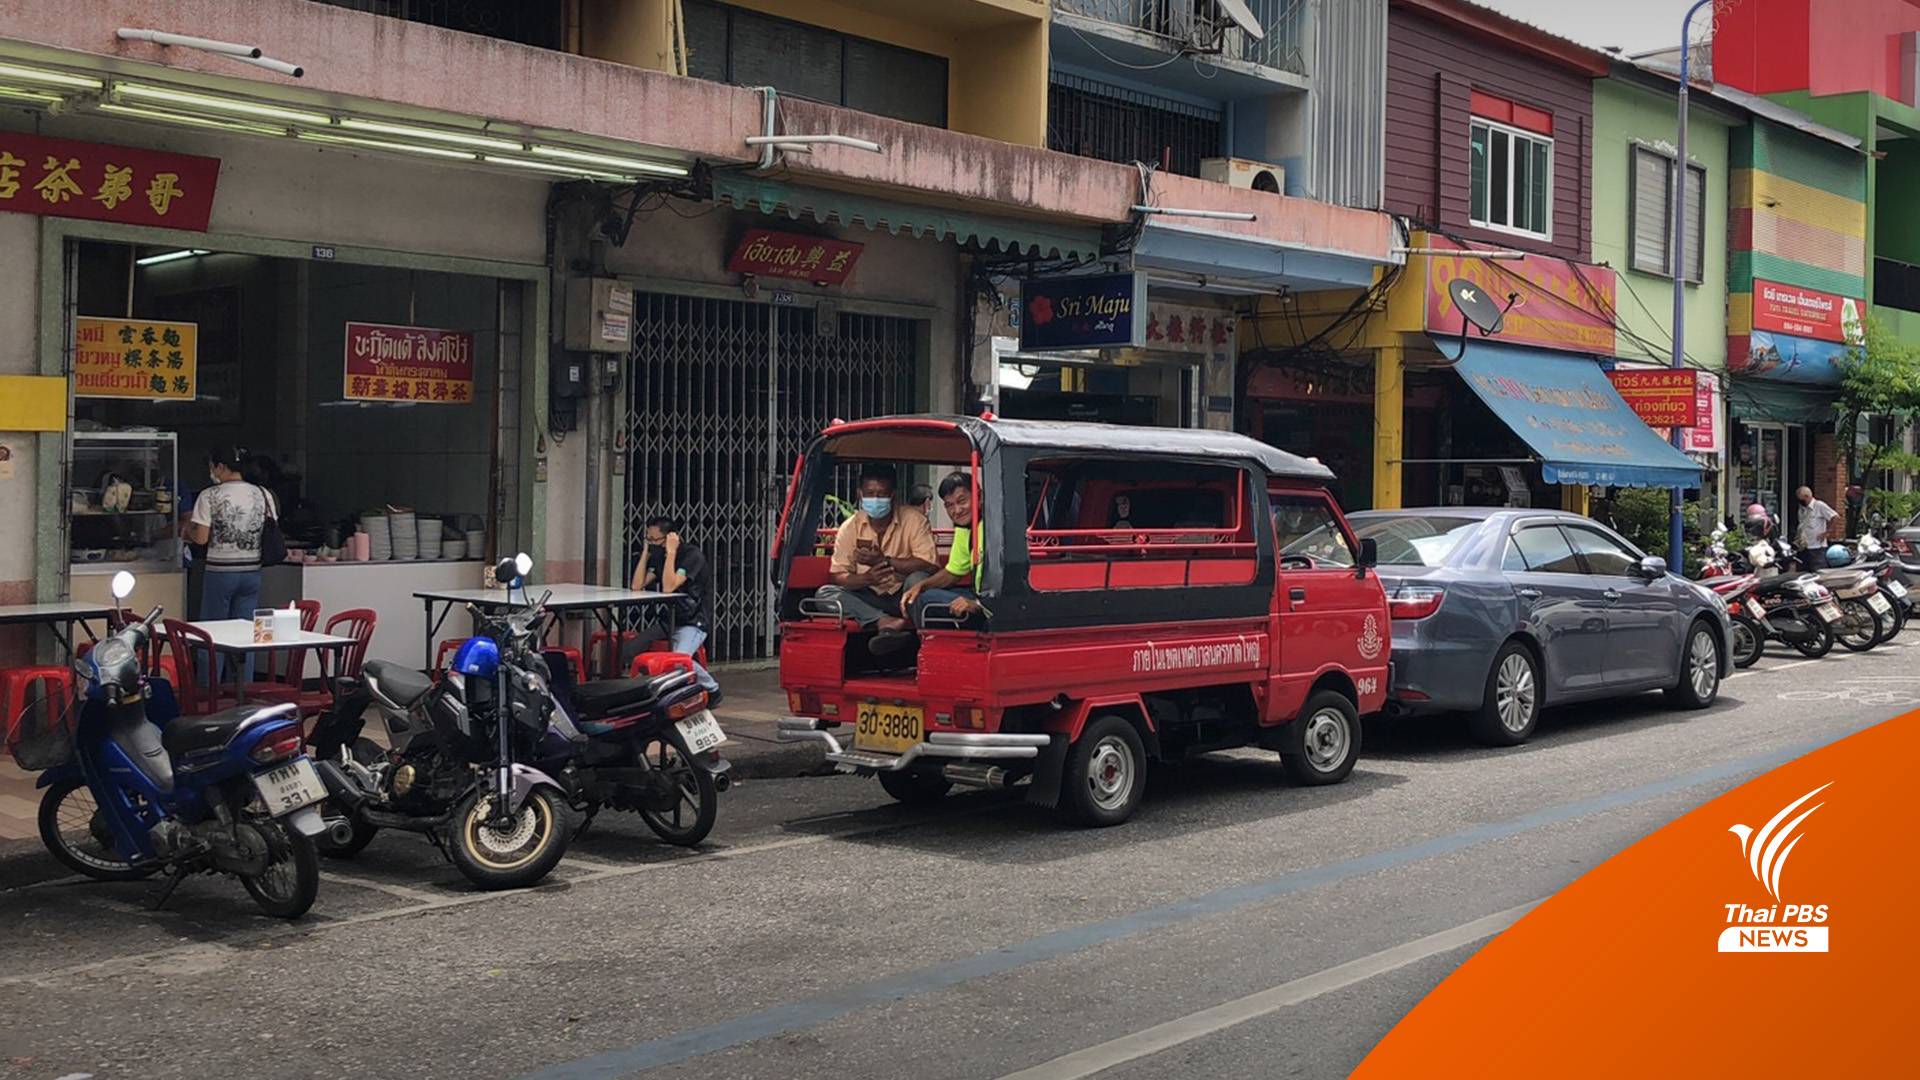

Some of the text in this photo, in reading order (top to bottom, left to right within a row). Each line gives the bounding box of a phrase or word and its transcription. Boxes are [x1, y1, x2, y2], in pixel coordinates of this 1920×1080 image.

[1056, 292, 1131, 321] Sri Maju
[859, 711, 919, 740] 30-3880
[695, 732, 719, 750] 983
[281, 788, 313, 809] 331
